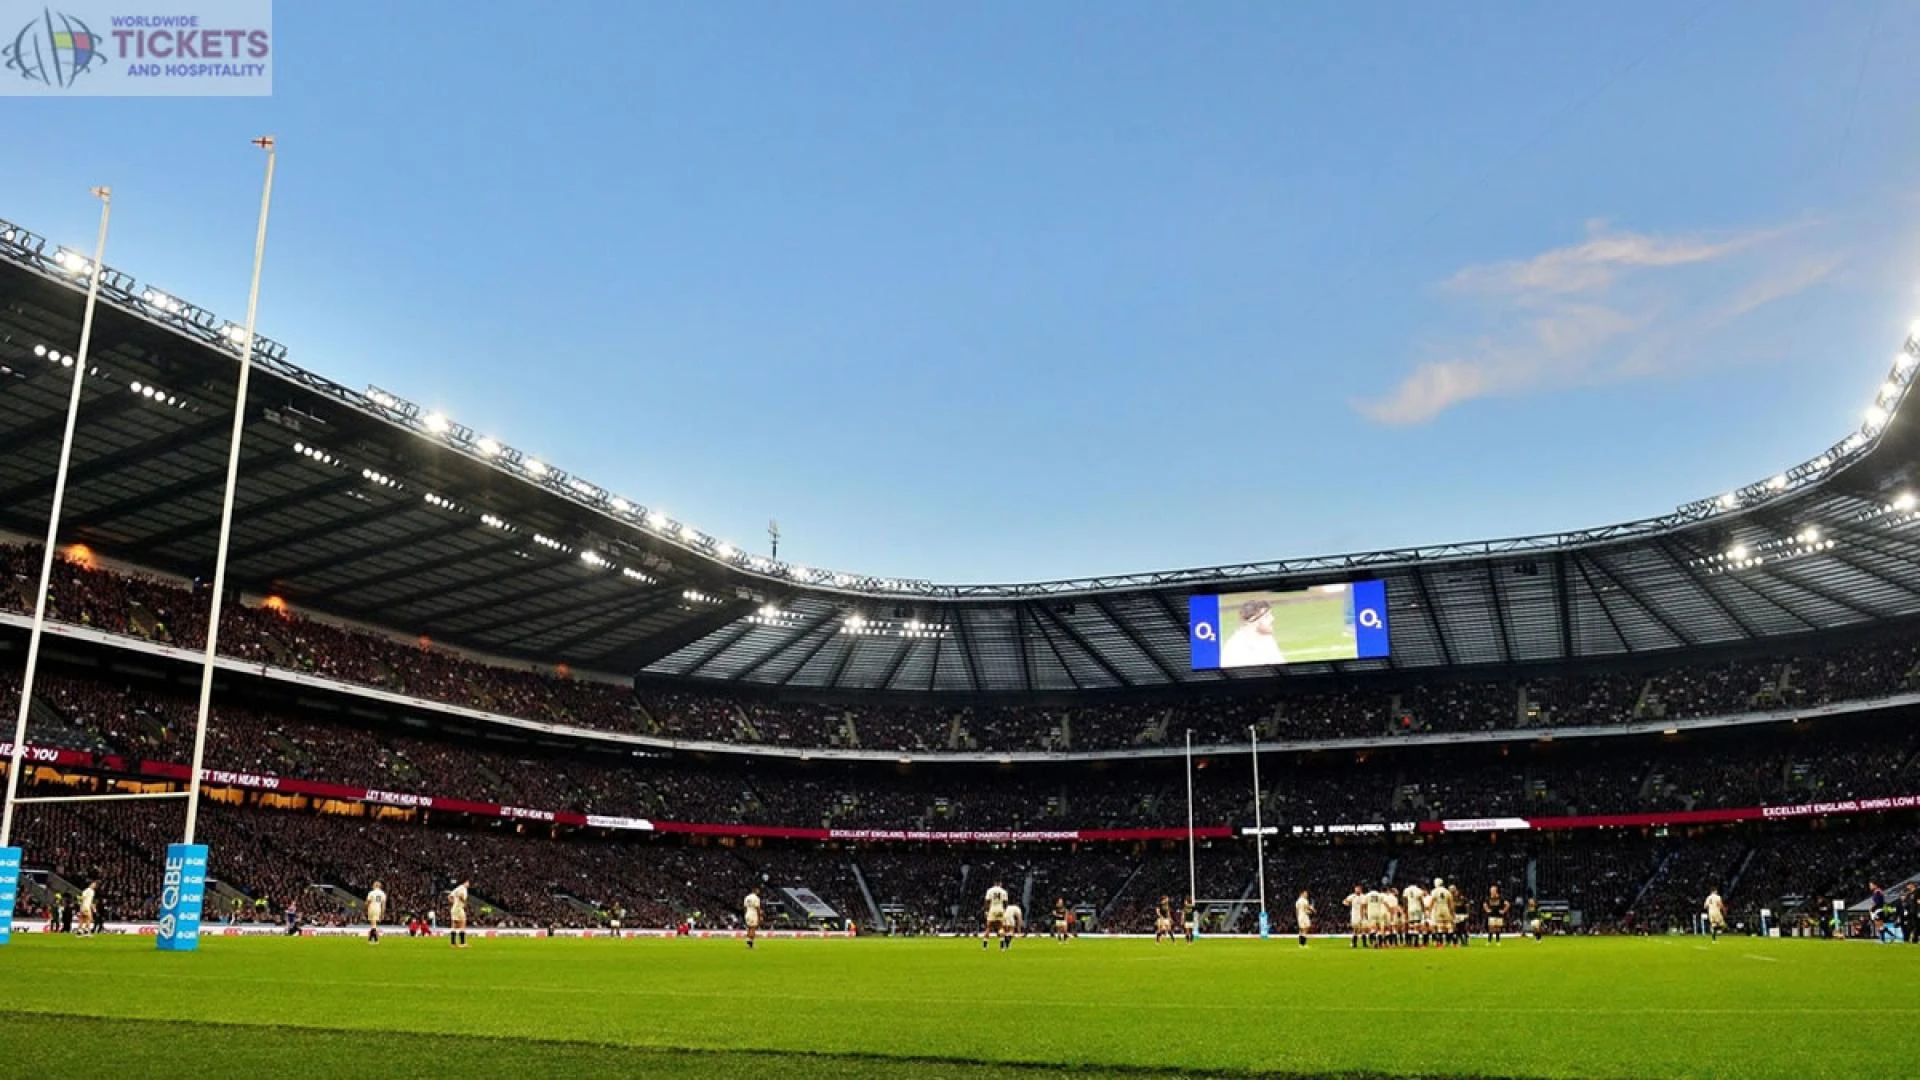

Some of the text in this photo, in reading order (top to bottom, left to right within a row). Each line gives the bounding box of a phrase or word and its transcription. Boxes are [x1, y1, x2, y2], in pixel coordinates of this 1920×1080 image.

[32, 746, 59, 761] YOU
[213, 771, 237, 785] THEM
[238, 773, 259, 786] HEAR
[262, 776, 279, 788] YOU
[163, 857, 183, 910] QBE
